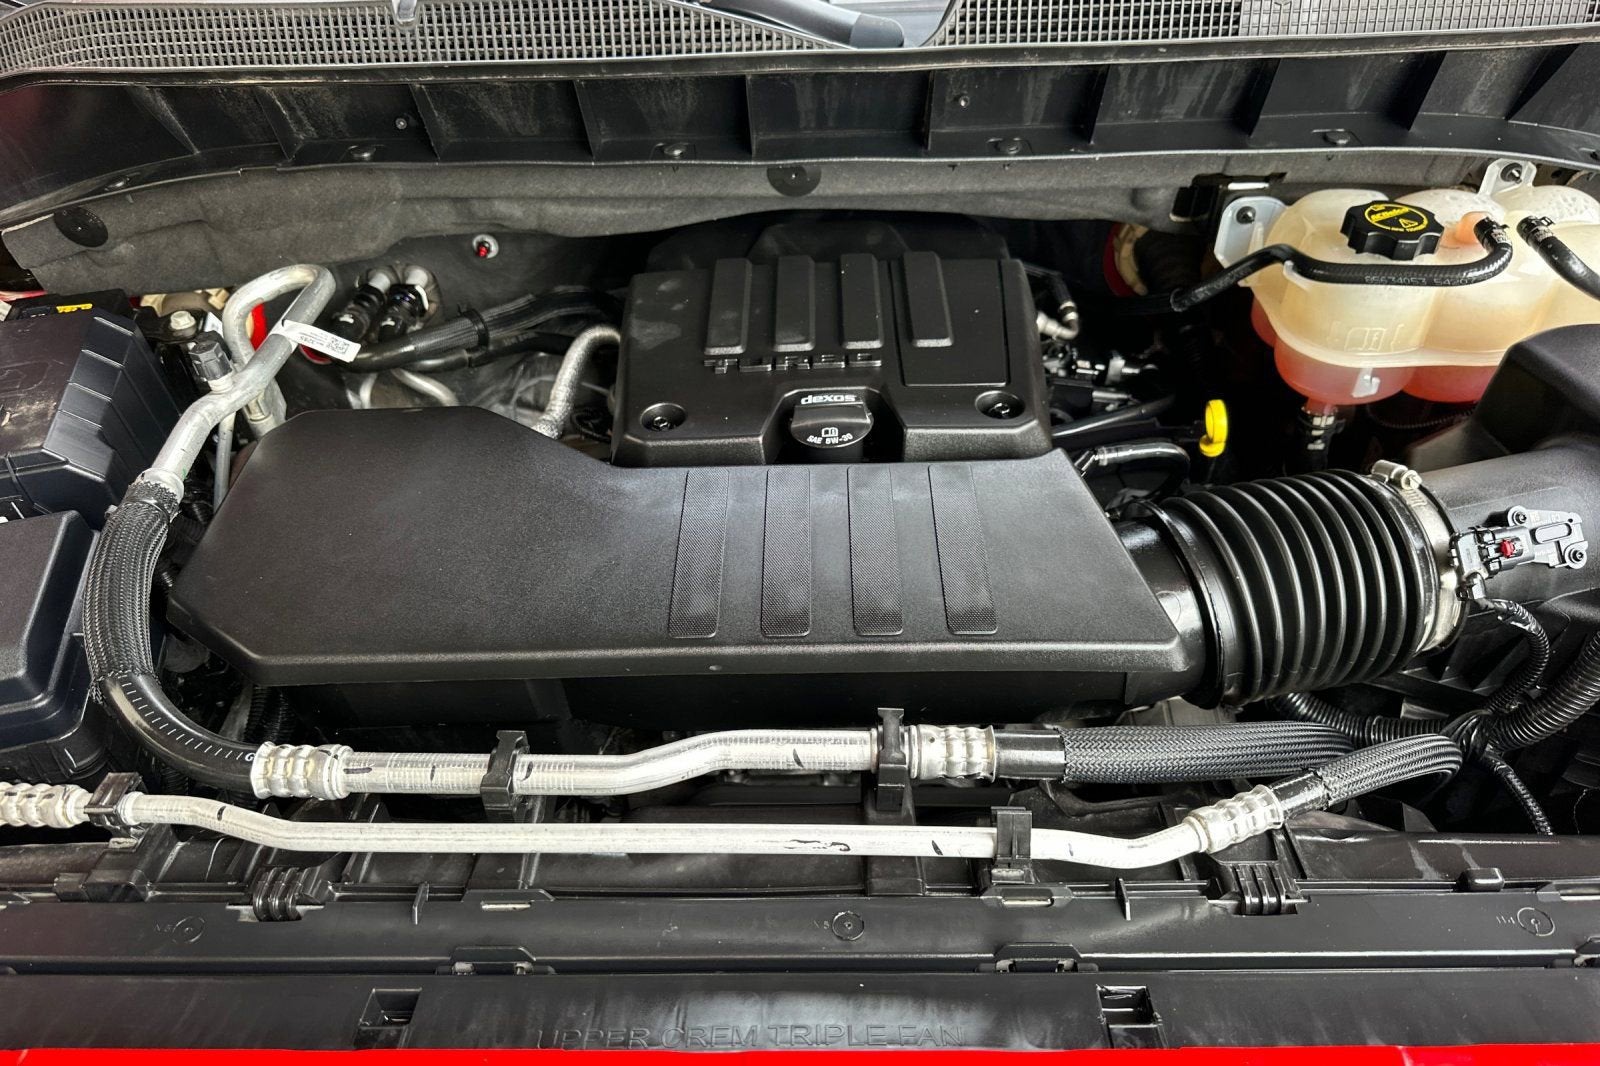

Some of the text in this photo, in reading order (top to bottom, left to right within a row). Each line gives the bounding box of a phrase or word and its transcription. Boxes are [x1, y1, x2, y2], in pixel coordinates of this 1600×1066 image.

[800, 394, 857, 405] dexos
[806, 434, 823, 445] SAE
[537, 1028, 651, 1050] UPPER
[767, 1024, 888, 1047] TRIPLE
[898, 1024, 967, 1047] FAN
